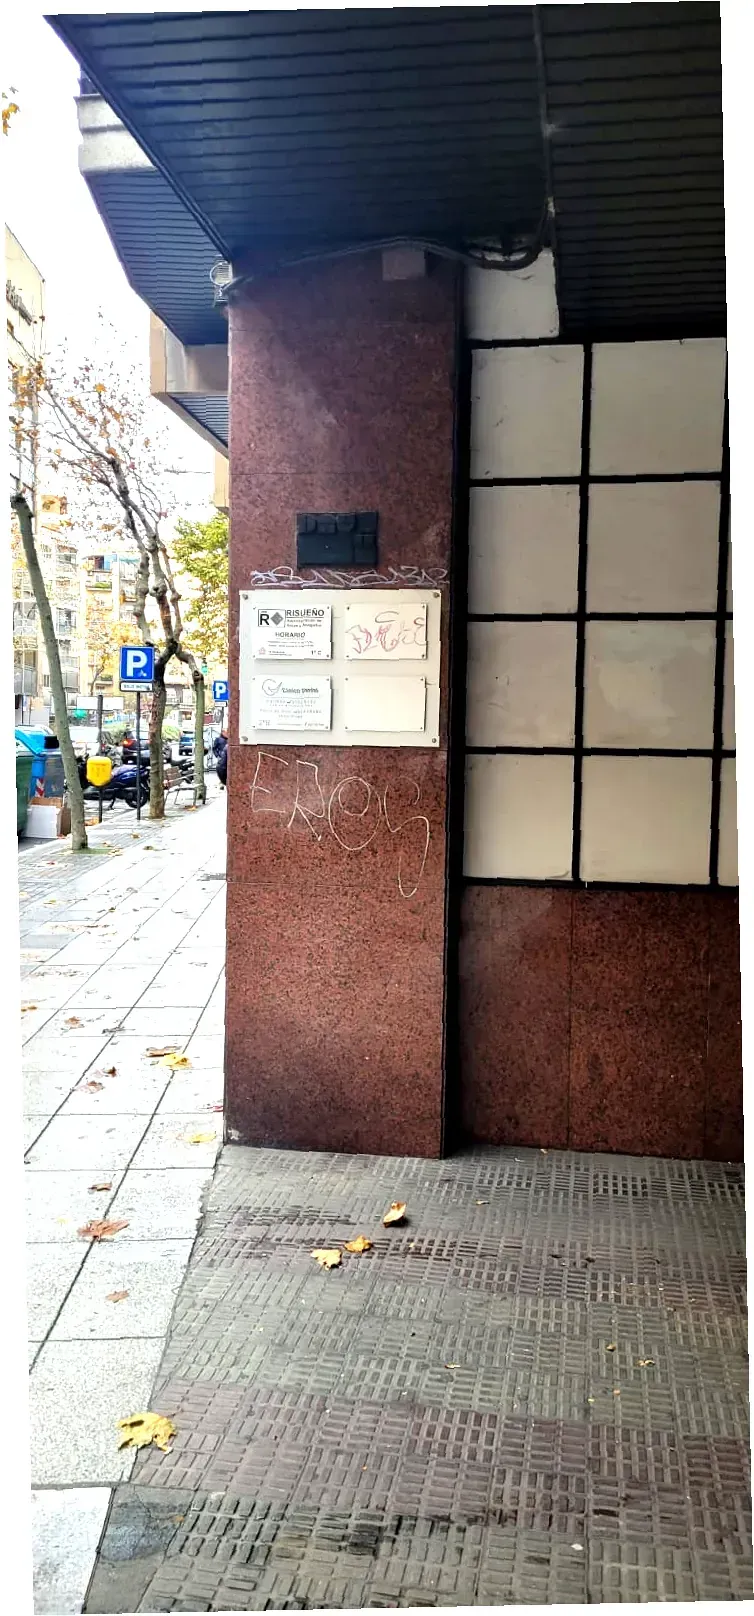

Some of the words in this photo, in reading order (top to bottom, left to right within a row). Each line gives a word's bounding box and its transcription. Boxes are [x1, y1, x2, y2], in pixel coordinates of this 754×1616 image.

[286, 607, 325, 616] RISUEÑO
[259, 613, 270, 626] R
[126, 649, 148, 677] P
[215, 682, 227, 699] P
